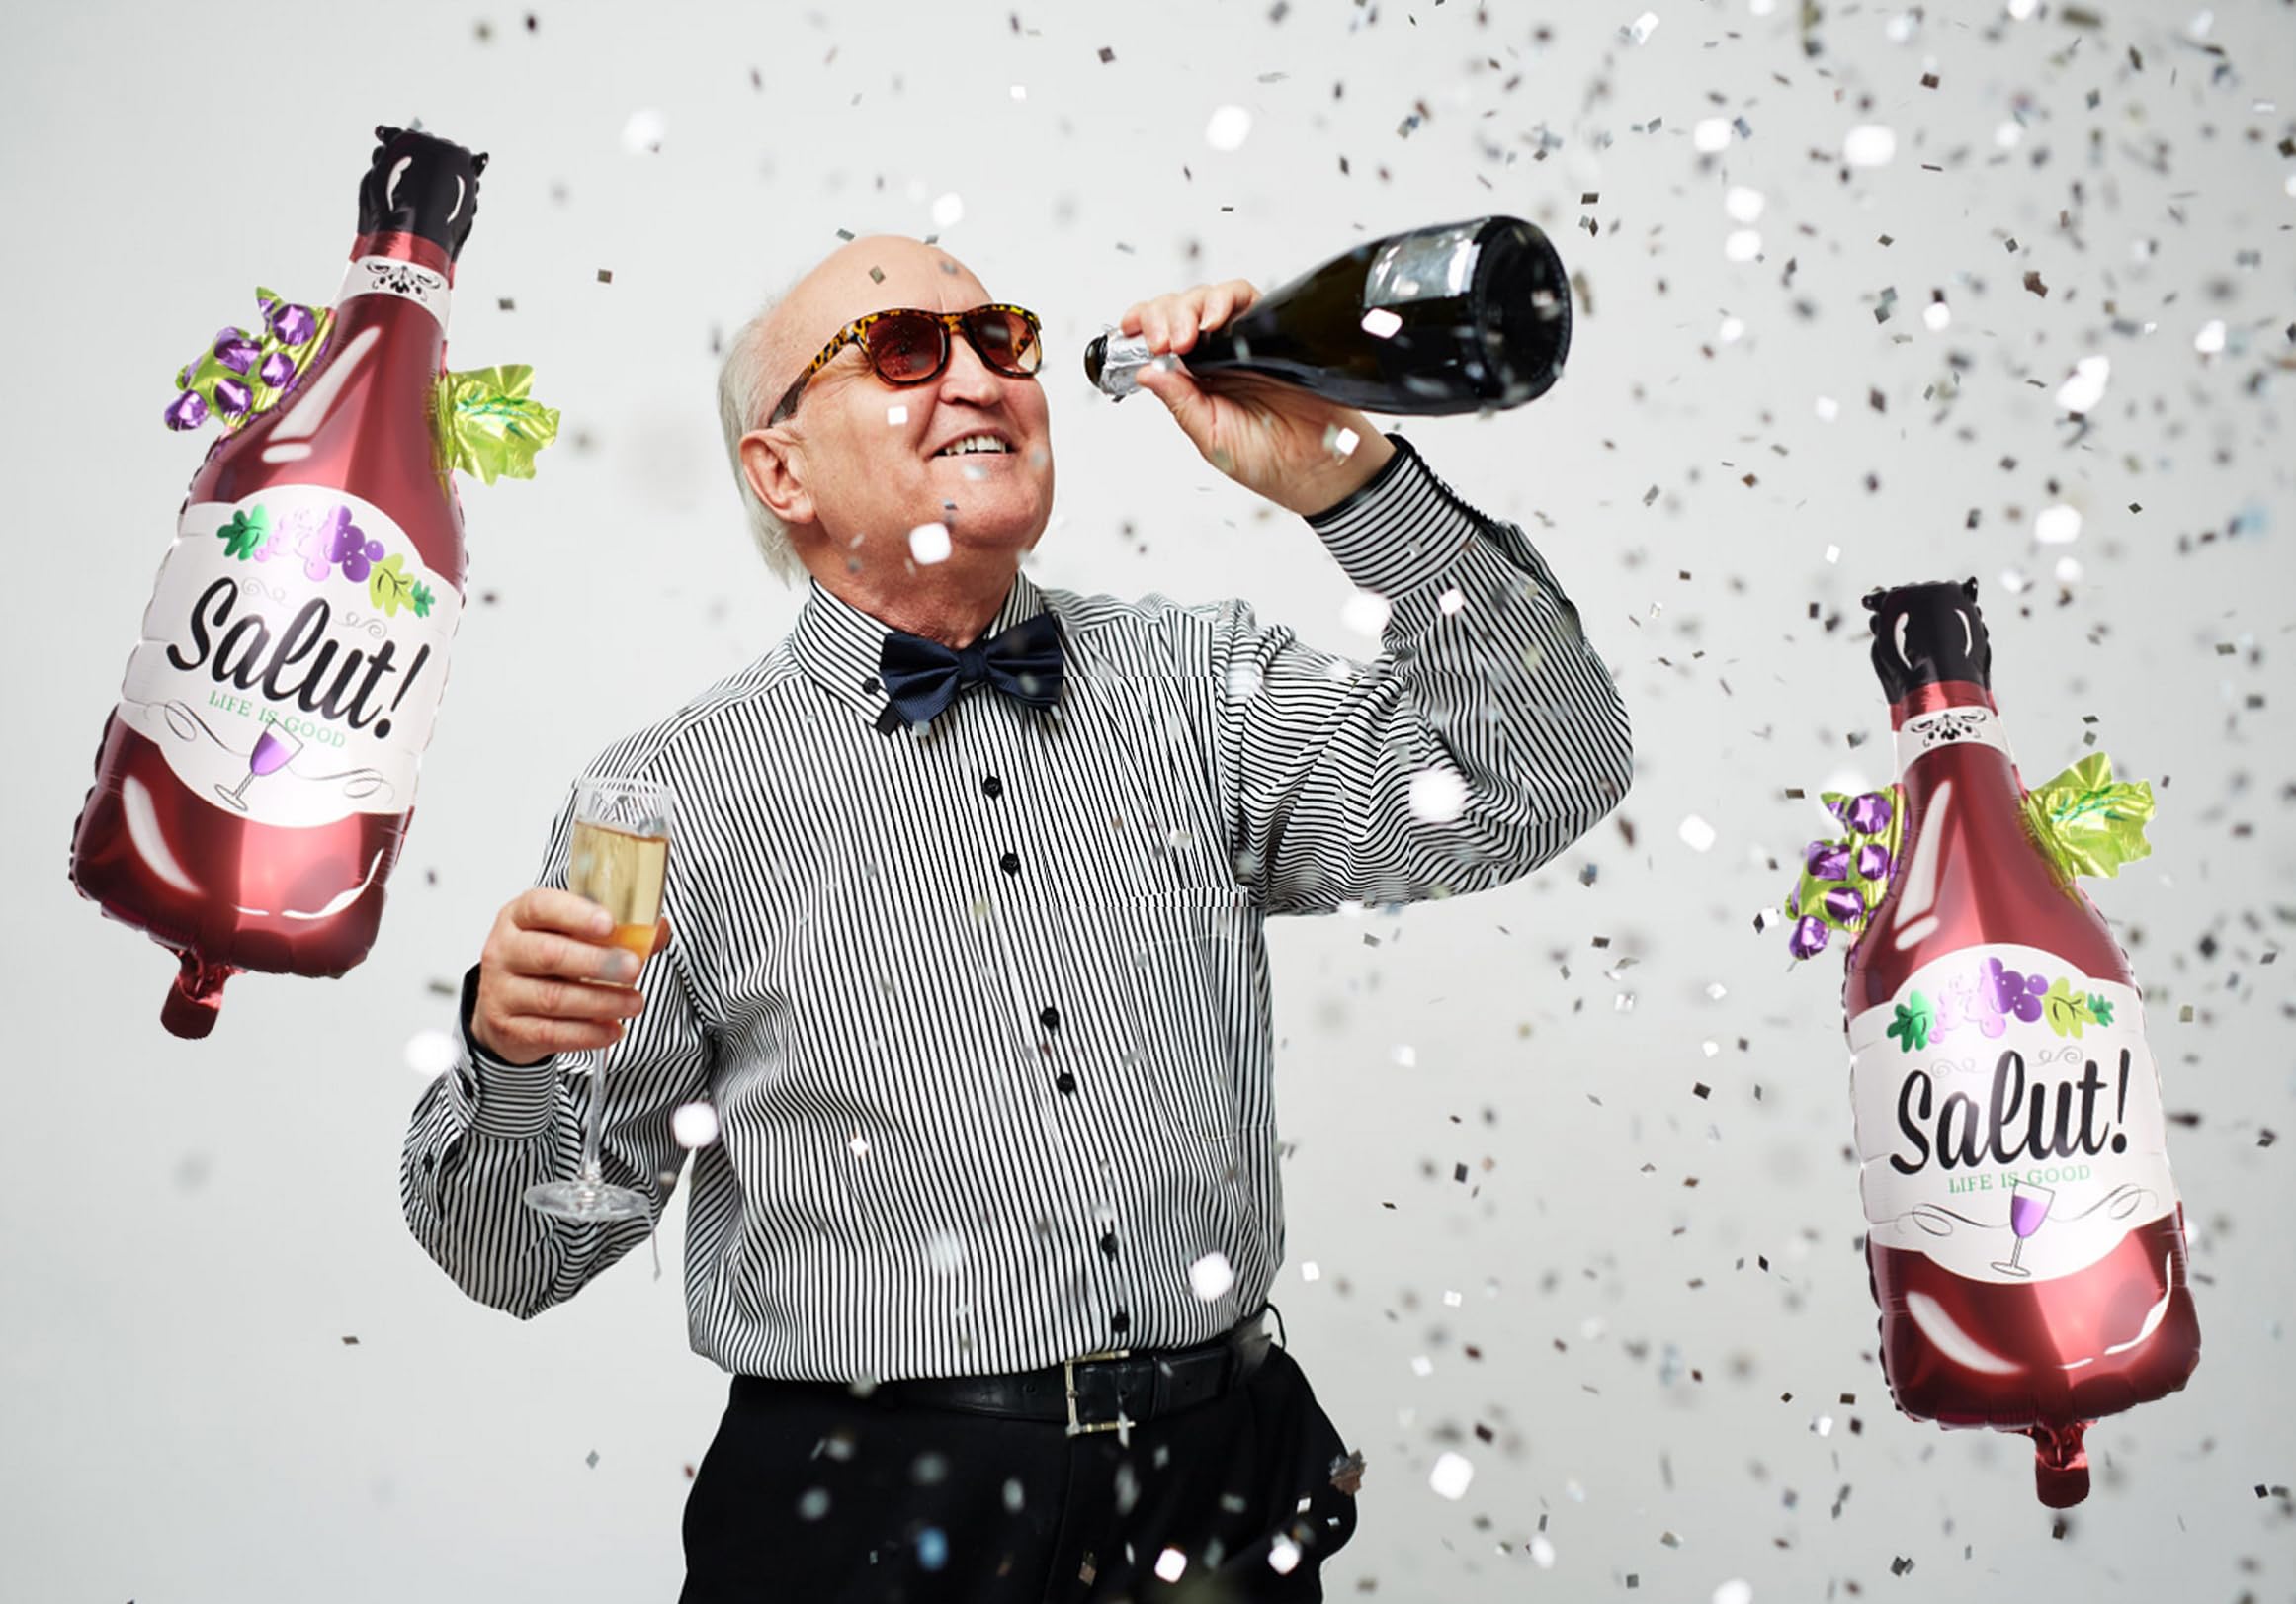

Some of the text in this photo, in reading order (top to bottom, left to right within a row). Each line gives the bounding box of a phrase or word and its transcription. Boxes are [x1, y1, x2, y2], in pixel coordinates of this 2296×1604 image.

[167, 577, 430, 738] Salut!
[209, 690, 346, 748] LIFE IS GOOD
[1890, 1049, 2130, 1175] Salut!
[1948, 1164, 2091, 1194] LIFE IS GOOD
